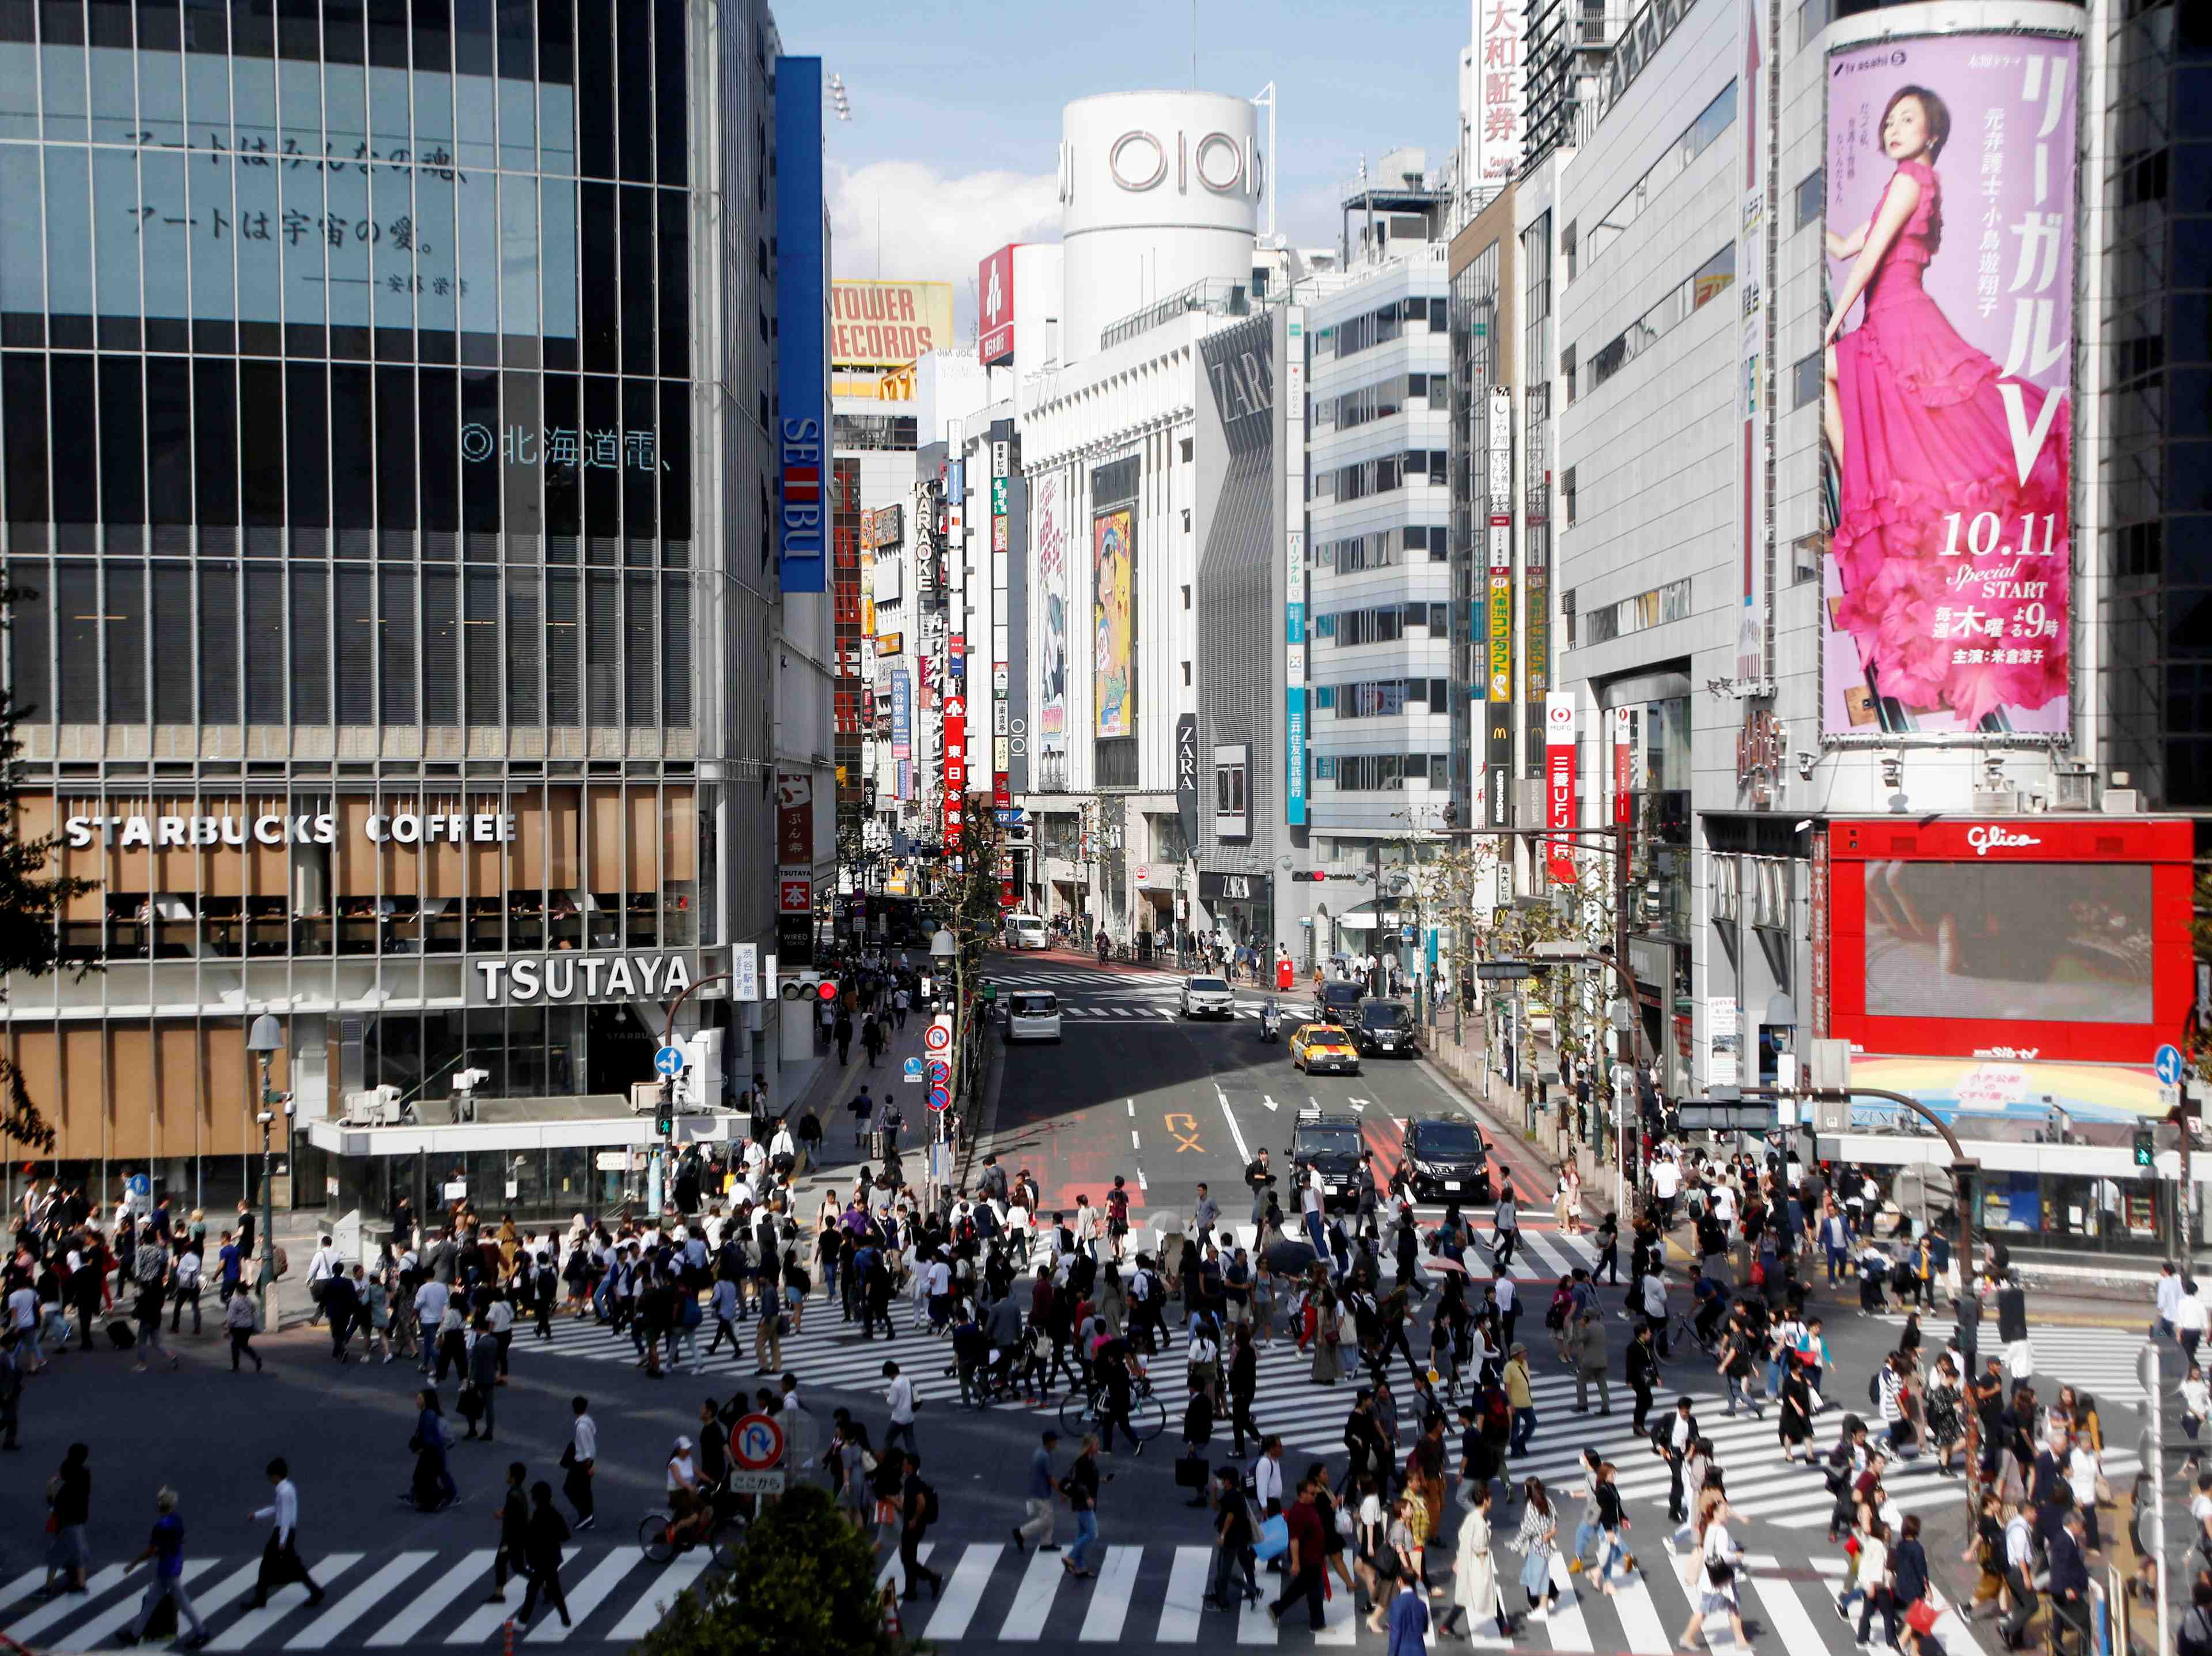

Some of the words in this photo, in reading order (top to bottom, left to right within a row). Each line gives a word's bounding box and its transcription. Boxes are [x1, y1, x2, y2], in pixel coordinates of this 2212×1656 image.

[1483, 1, 1518, 143] 大和証券
[126, 206, 433, 254] アートは宇宙の愛。
[832, 286, 916, 322] TOWER
[997, 444, 1005, 477] 岩本ビル
[783, 417, 821, 560] SEIBU
[915, 482, 933, 592] KARAOKE
[1938, 511, 2055, 557] 10.11
[1946, 558, 2021, 591] Special
[1982, 581, 2048, 599] START
[1932, 604, 2003, 639] 毎週木曜
[893, 681, 905, 727] 渋谷整形
[1179, 726, 1195, 790] ZARA
[1290, 713, 1302, 798] 三井住友信託銀行
[946, 744, 962, 848] 東日本銀行
[65, 814, 334, 846] STARBUCKS
[365, 813, 516, 843] COFFEE
[1967, 825, 2041, 856] Glico
[784, 885, 807, 908] 本
[1223, 875, 1249, 899] ZARA
[1501, 866, 1509, 901] 丸大ビル
[783, 933, 808, 941] WIRED
[476, 955, 691, 1000] TSUTAYA
[743, 948, 753, 996] 渋谷駅前
[734, 1476, 781, 1491] ここから
